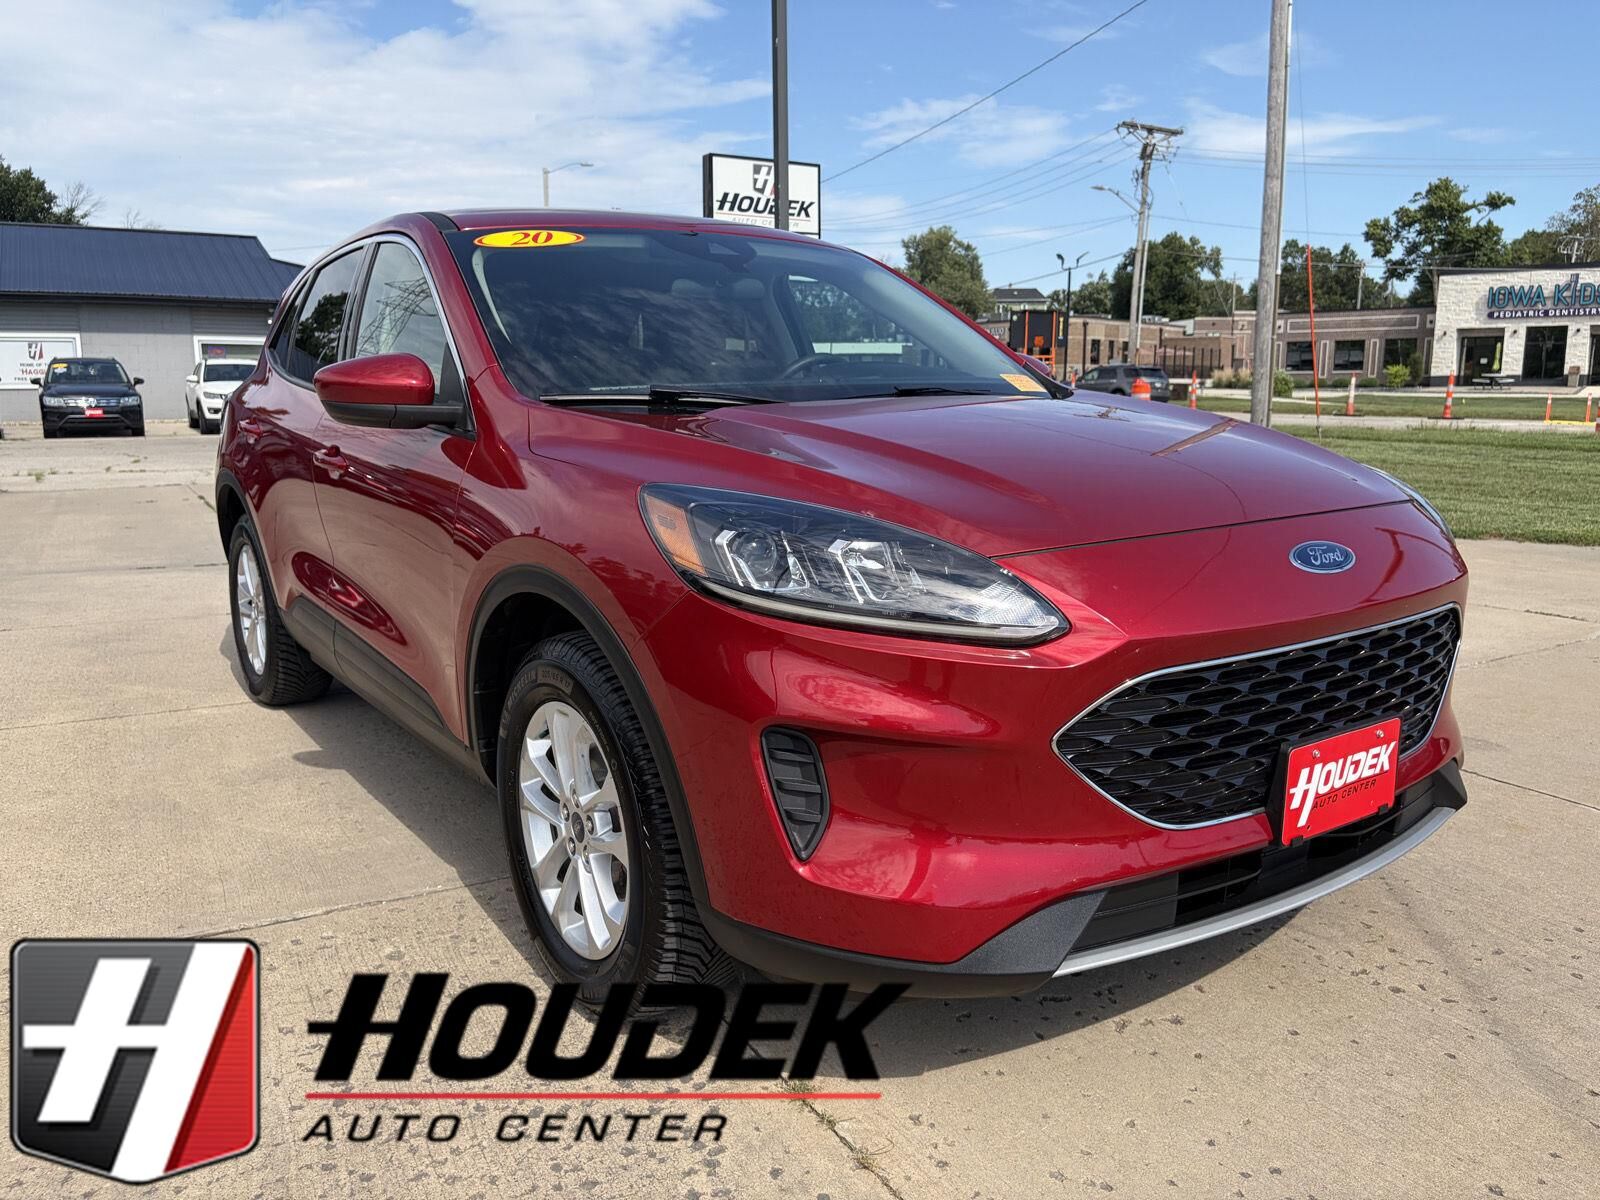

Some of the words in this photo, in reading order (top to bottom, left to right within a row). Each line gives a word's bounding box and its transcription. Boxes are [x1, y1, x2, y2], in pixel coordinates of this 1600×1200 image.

[511, 231, 553, 245] 20
[1487, 285, 1546, 309] IOWA
[1493, 309, 1545, 319] PEDIATRIC
[1307, 546, 1344, 565] Ford
[1290, 741, 1396, 828] HOUDEK
[1312, 794, 1338, 809] AUTO
[1341, 779, 1377, 799] CENTER
